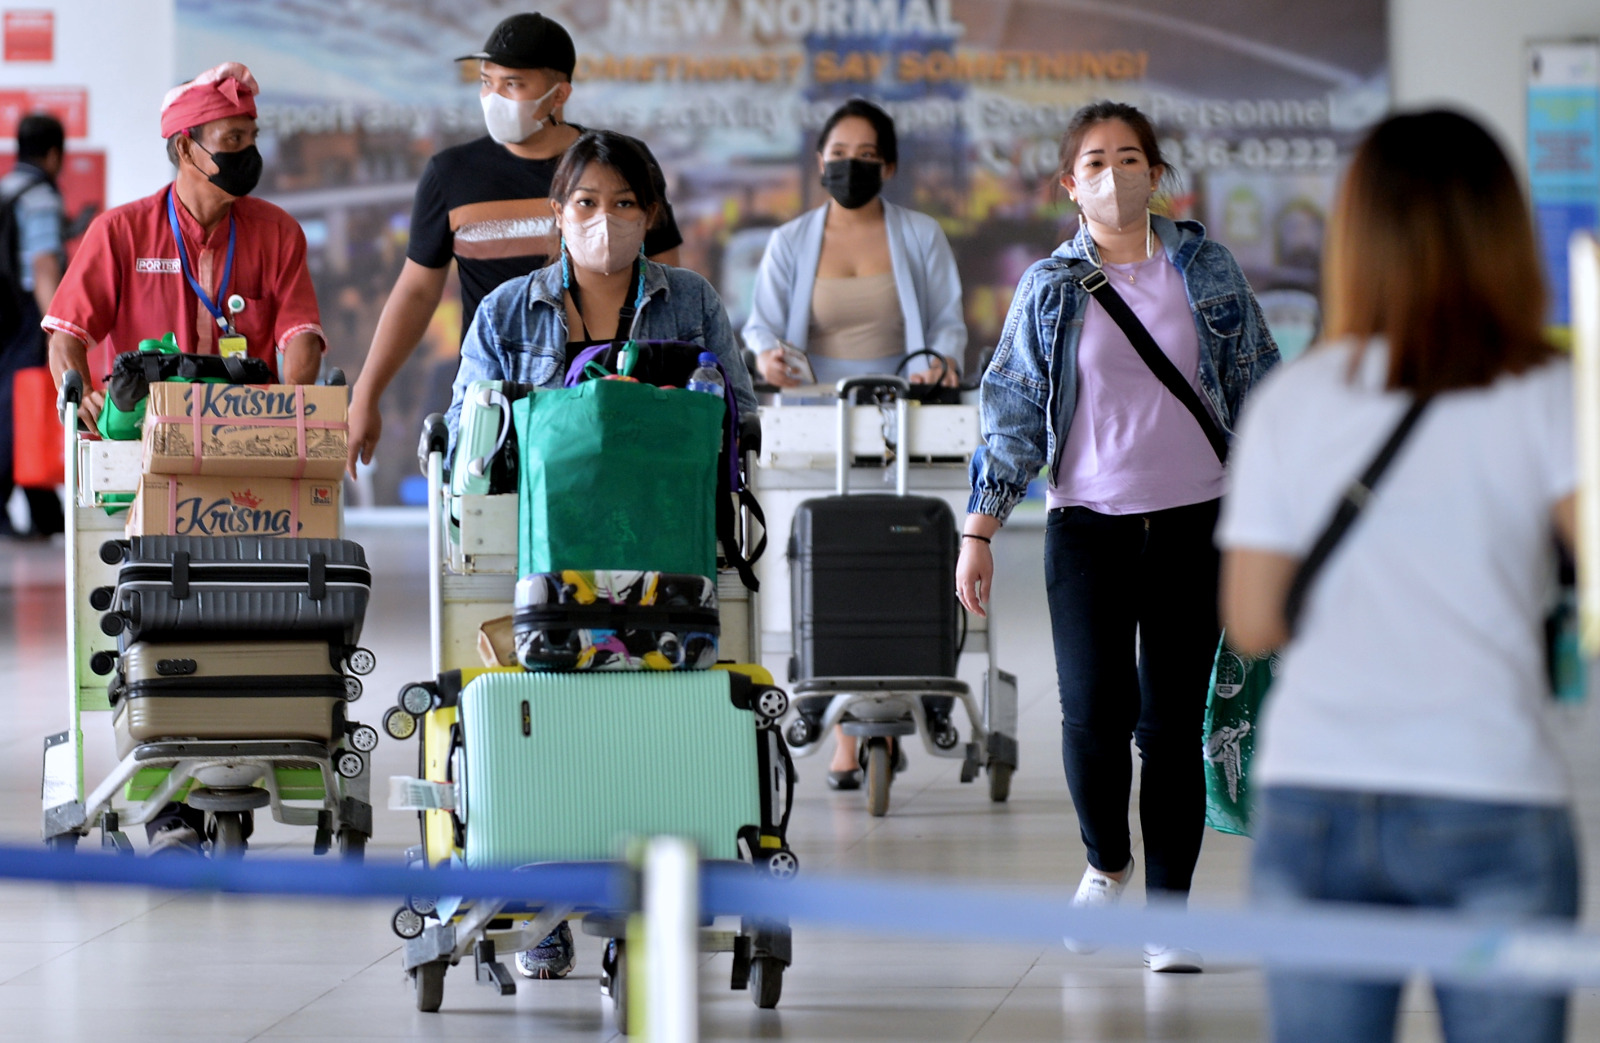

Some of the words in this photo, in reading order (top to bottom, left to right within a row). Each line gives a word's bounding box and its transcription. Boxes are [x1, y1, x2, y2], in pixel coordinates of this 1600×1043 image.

[608, 0, 723, 37] NEW
[743, 0, 964, 38] NORMAL
[573, 53, 799, 82] OMETHING?
[813, 51, 883, 82] SAY
[257, 101, 358, 140] eport
[139, 260, 180, 272] PORTER
[183, 383, 317, 418] Krisna
[175, 497, 304, 536] Krisna
